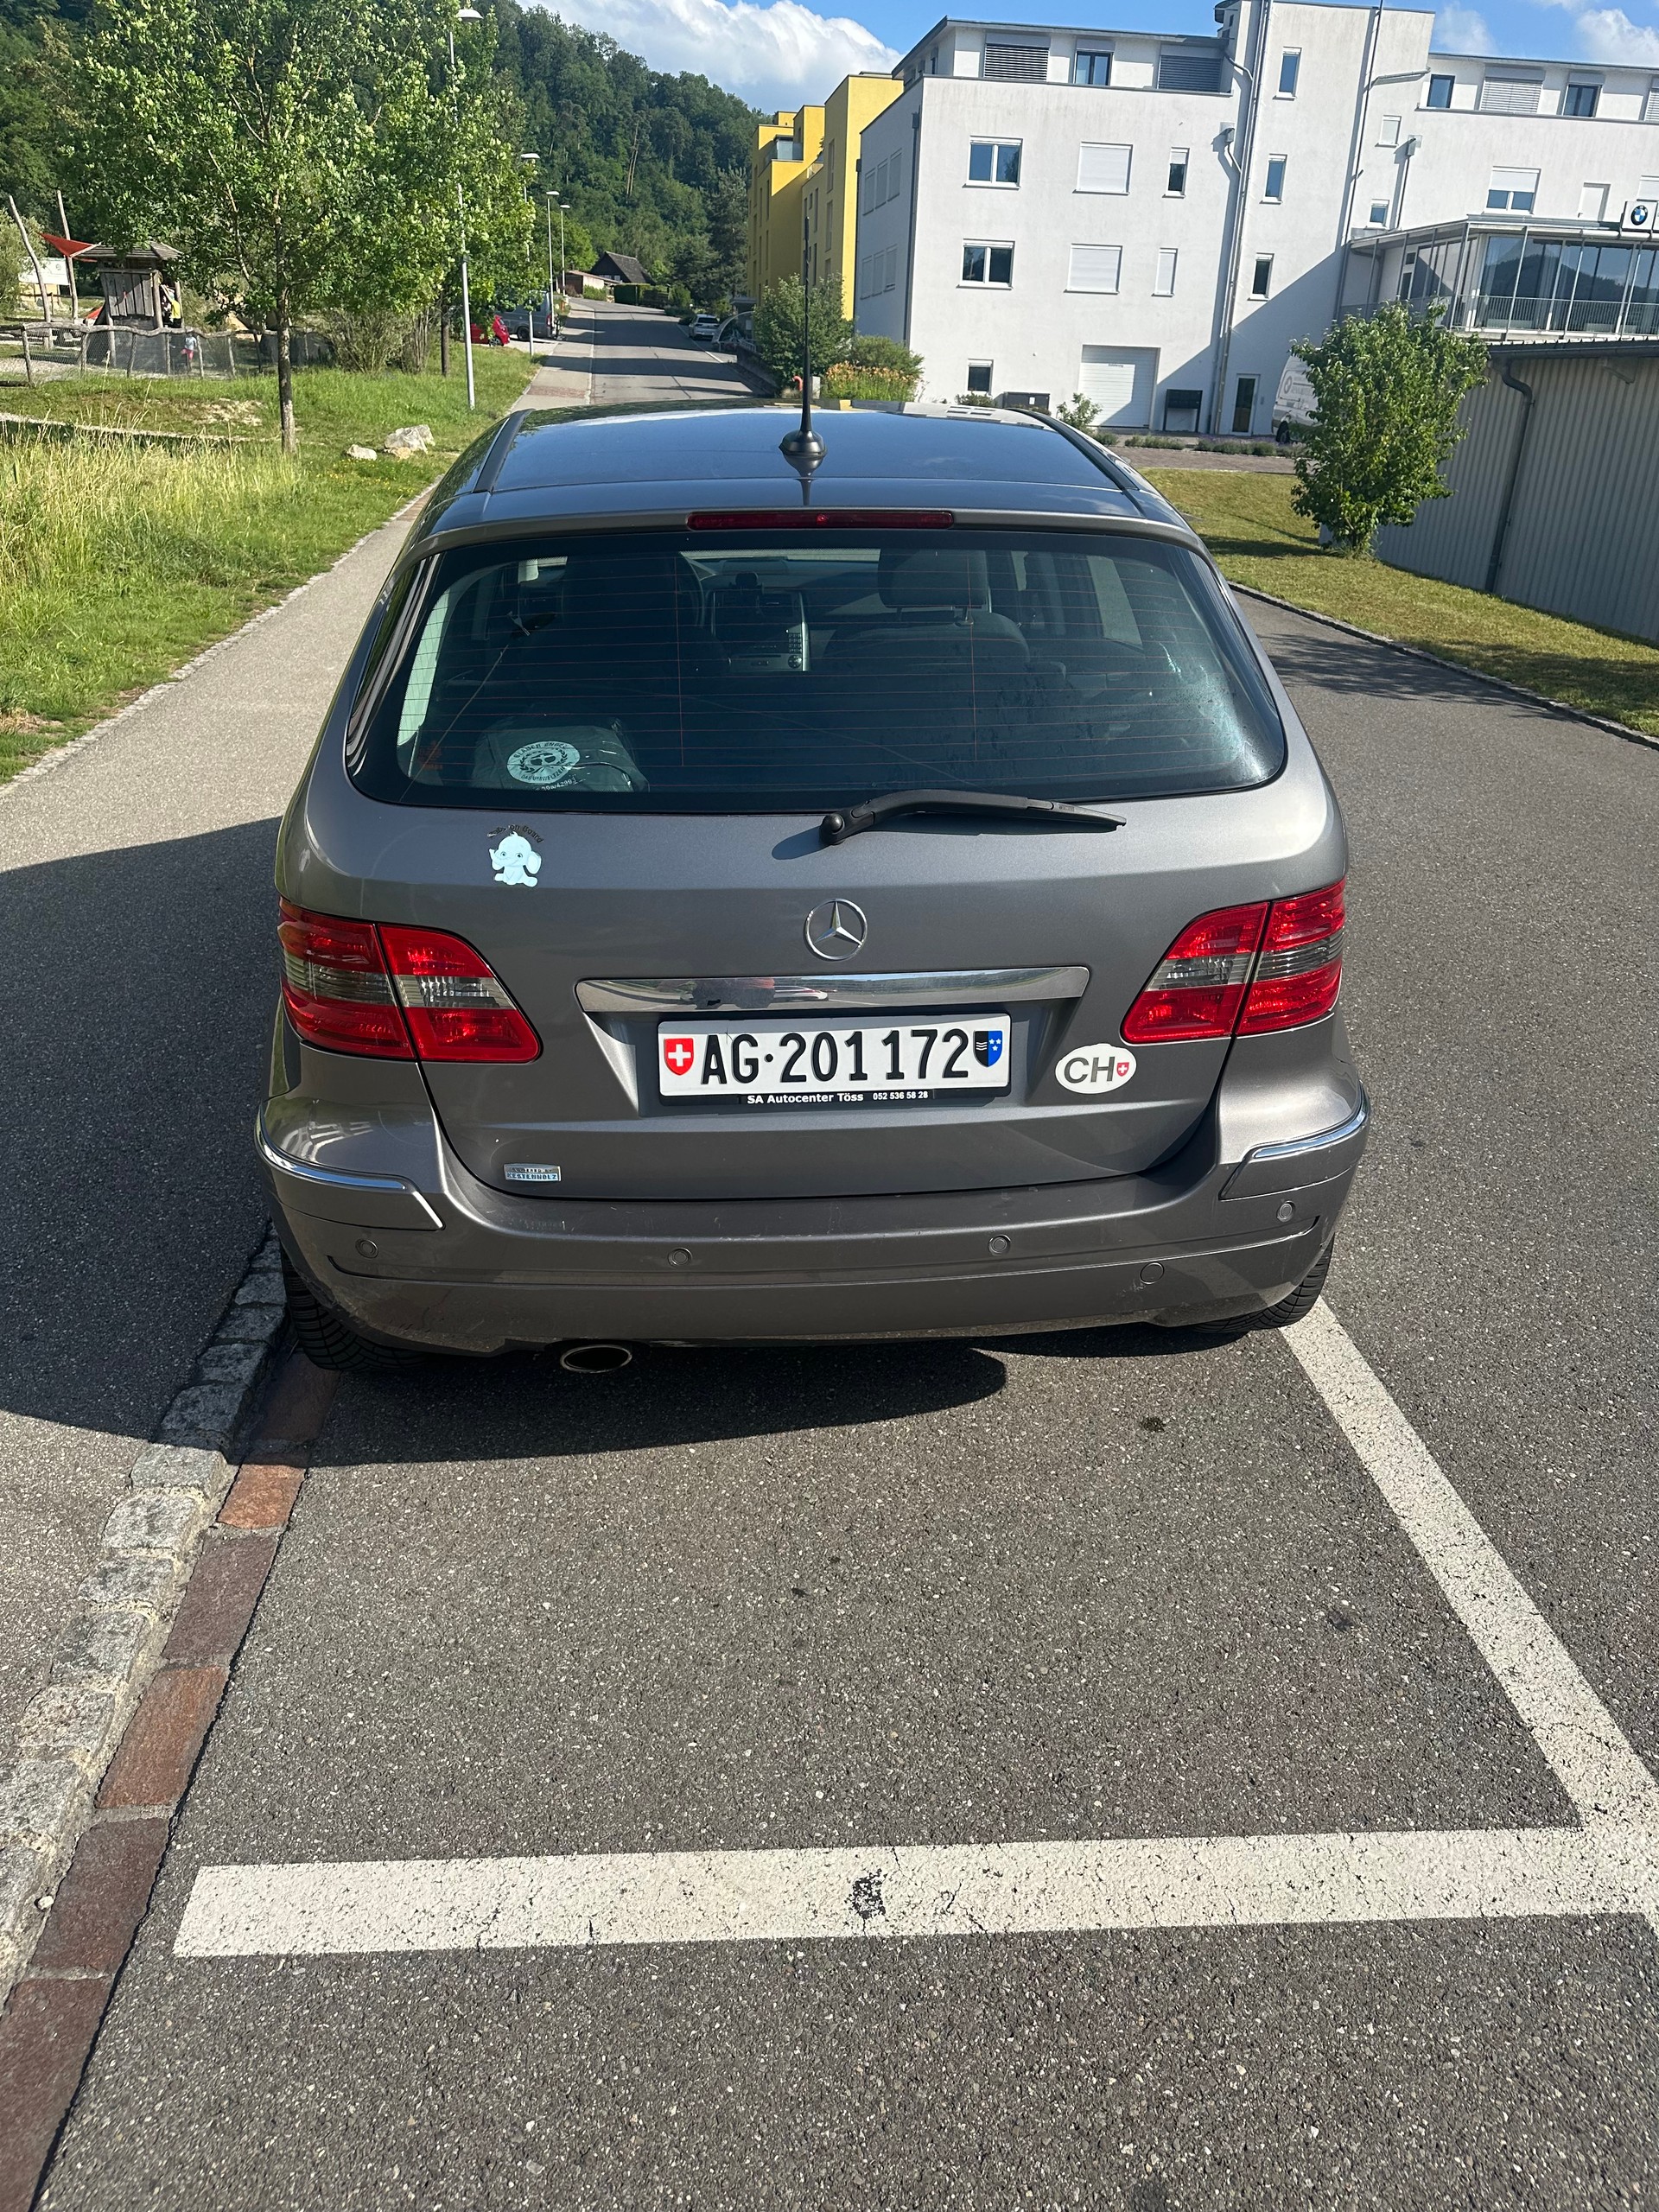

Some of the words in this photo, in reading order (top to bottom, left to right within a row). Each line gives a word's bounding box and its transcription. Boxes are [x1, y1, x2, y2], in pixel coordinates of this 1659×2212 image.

[1064, 1056, 1116, 1084] CH
[747, 1095, 764, 1103] SA
[766, 1093, 834, 1103] Autocenter
[837, 1091, 864, 1102] Töss
[889, 1091, 905, 1100] 536
[918, 1090, 928, 1099] 28
